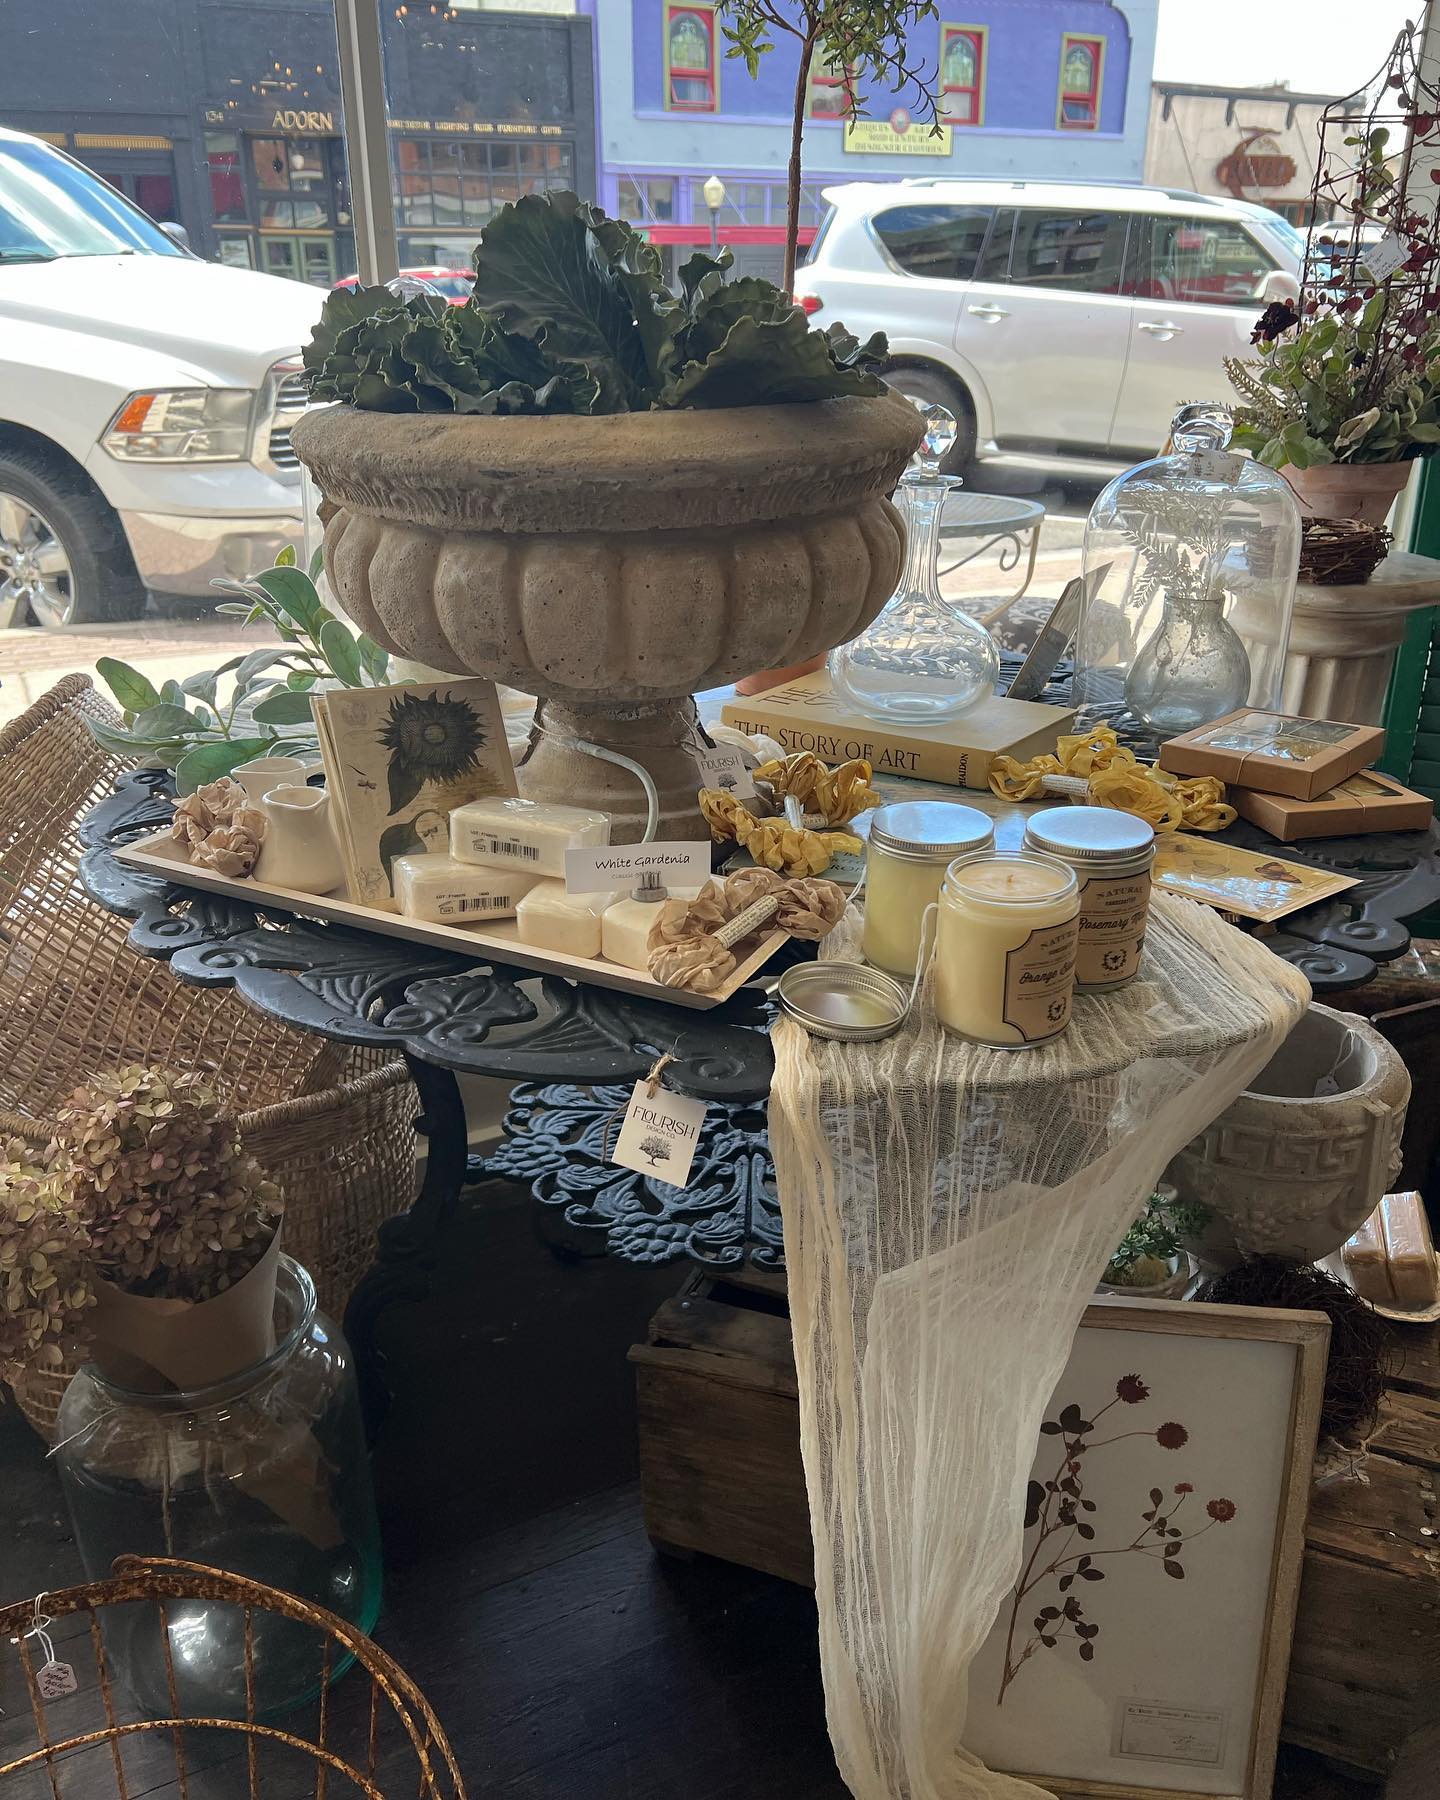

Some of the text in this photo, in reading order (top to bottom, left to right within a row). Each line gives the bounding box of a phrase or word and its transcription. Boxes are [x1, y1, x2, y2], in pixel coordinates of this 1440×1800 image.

[272, 110, 333, 131] ADORN
[733, 719, 921, 771] THE STORY OF ART
[700, 756, 740, 770] FLOURISH
[595, 853, 690, 870] White Gardenia
[1096, 886, 1143, 899] NATURAL
[1078, 917, 1130, 932] Rosemary
[1019, 969, 1058, 984] Orange
[633, 1106, 695, 1139] FLOURISH
[646, 1124, 665, 1136] DESIGN
